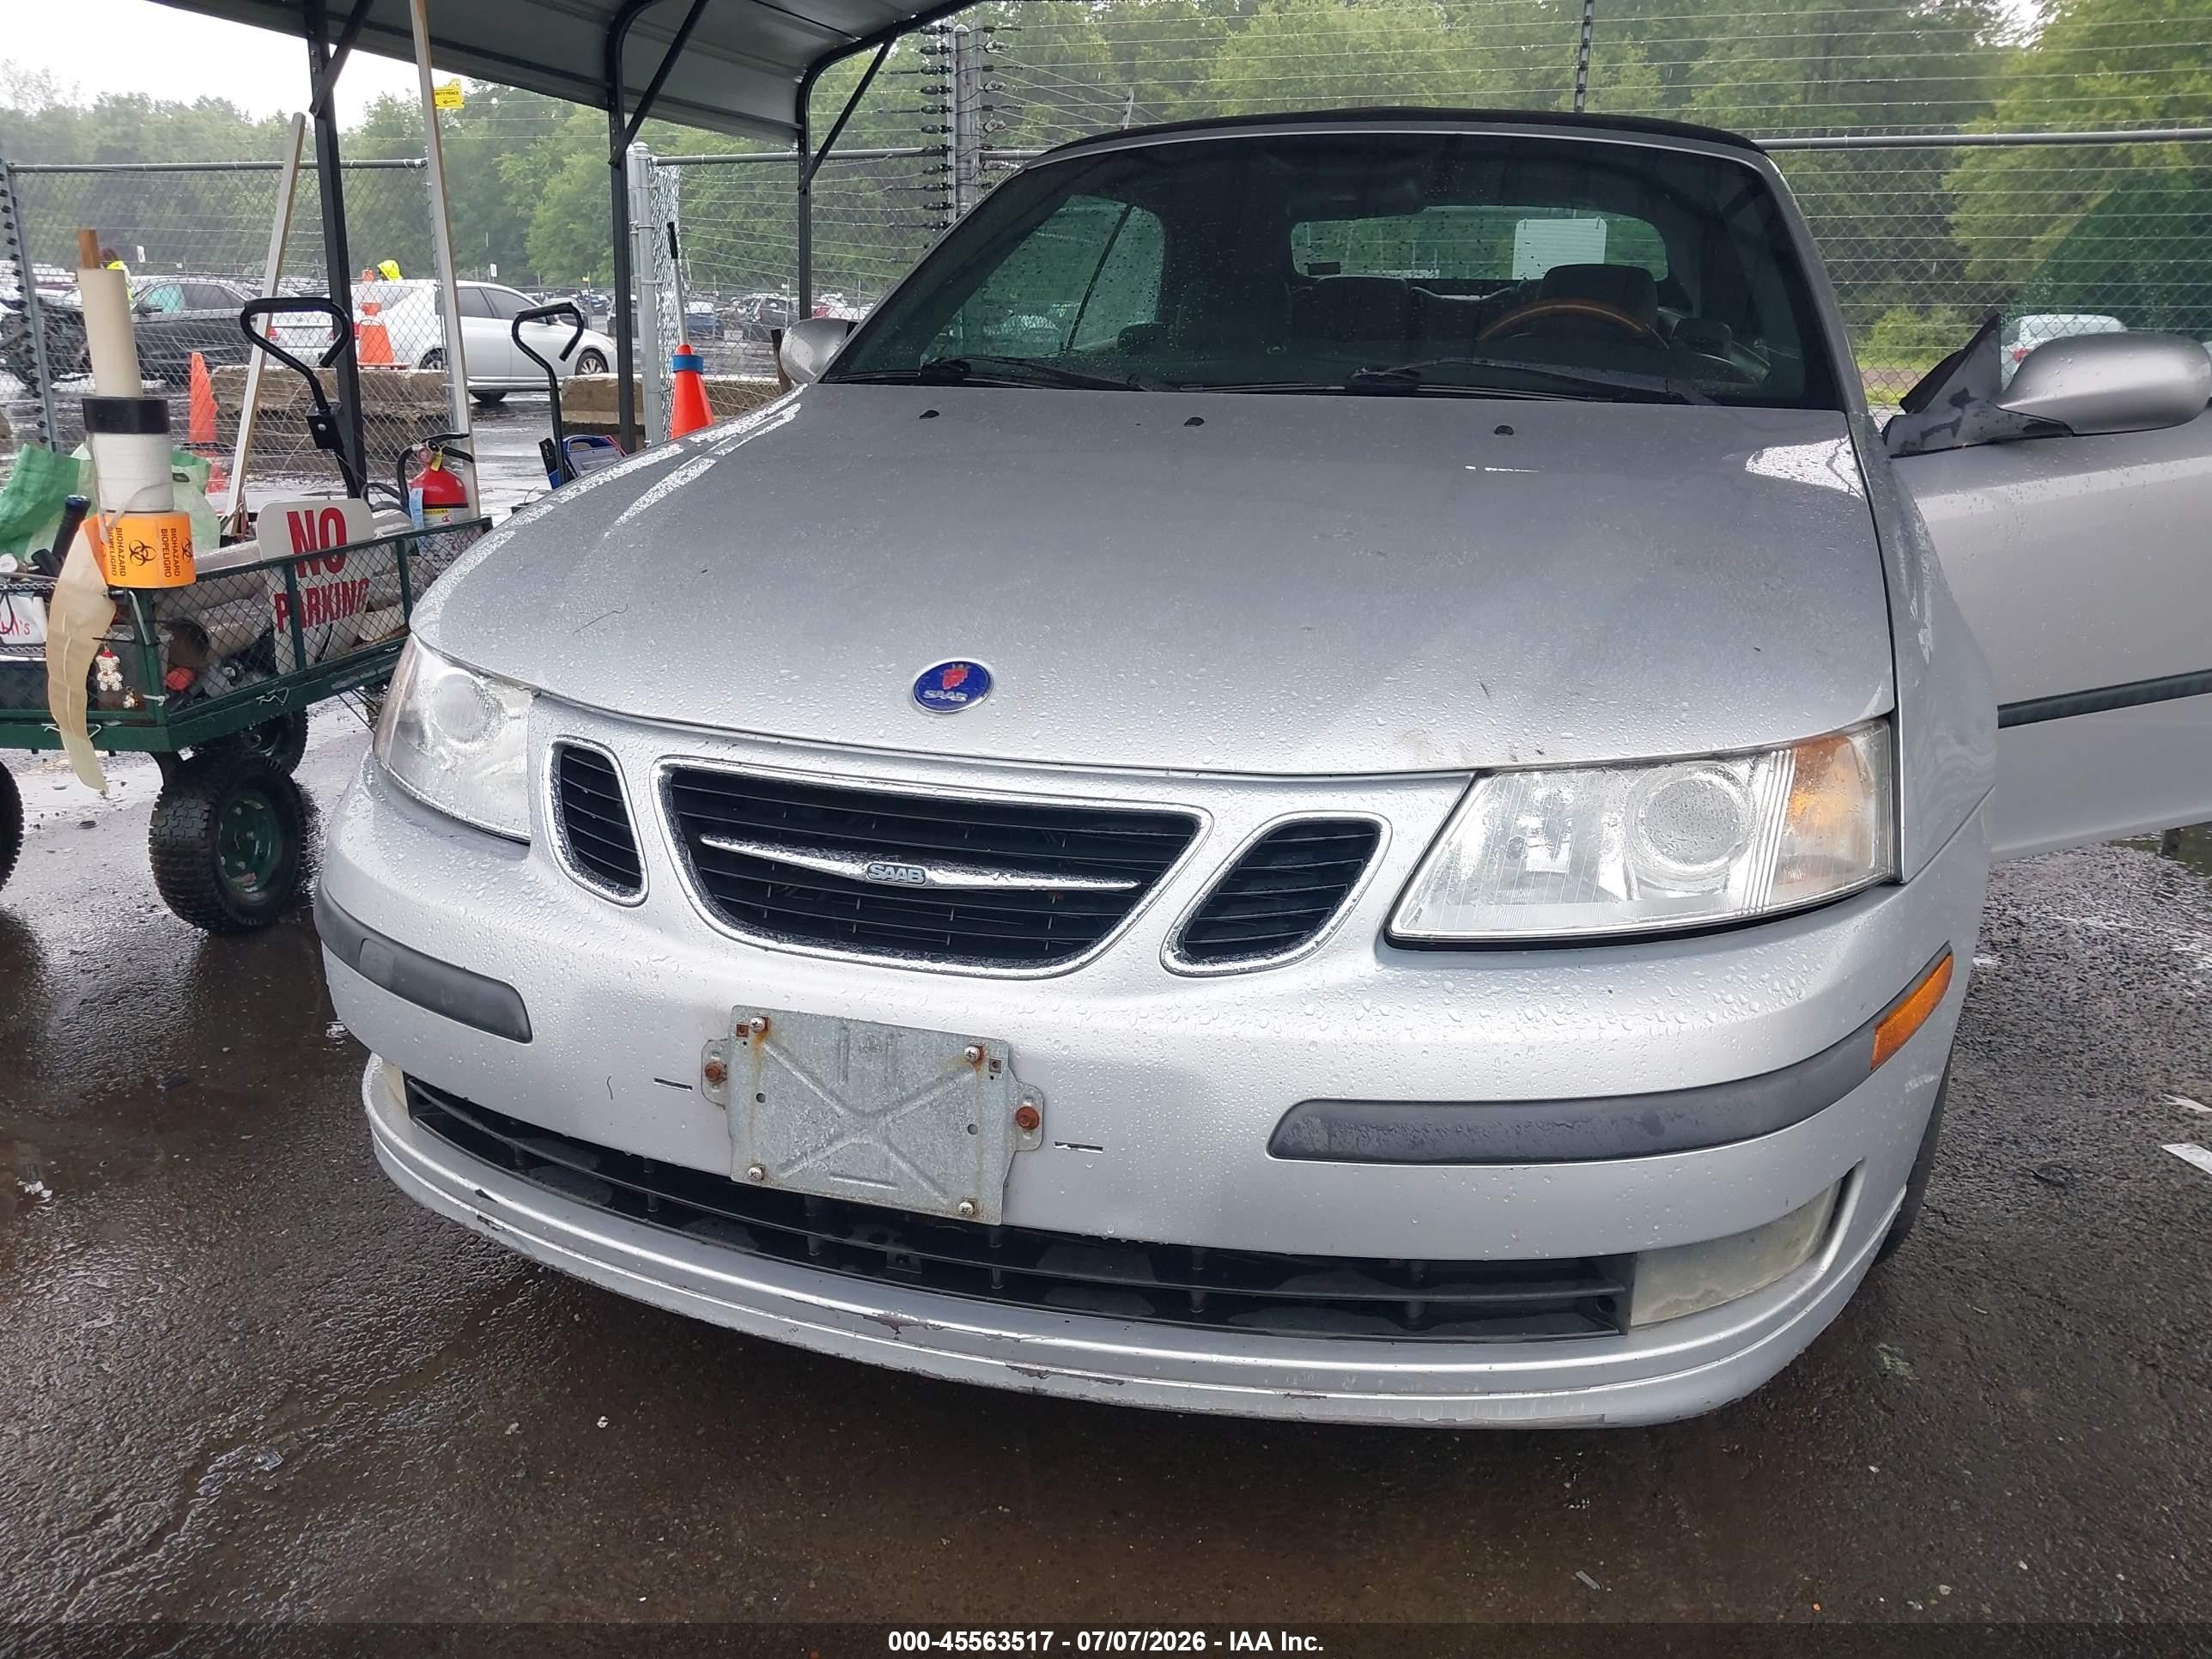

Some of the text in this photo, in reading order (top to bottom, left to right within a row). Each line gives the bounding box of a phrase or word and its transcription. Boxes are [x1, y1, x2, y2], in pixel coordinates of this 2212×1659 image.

[116, 527, 126, 577] BIOHAZARD
[161, 528, 173, 578] BIOPELIGRO
[170, 528, 180, 577] BIOHAZARD
[287, 507, 347, 578] NO
[274, 578, 369, 634] PARKING
[922, 690, 969, 702] SAAB
[867, 864, 925, 884] SAAB
